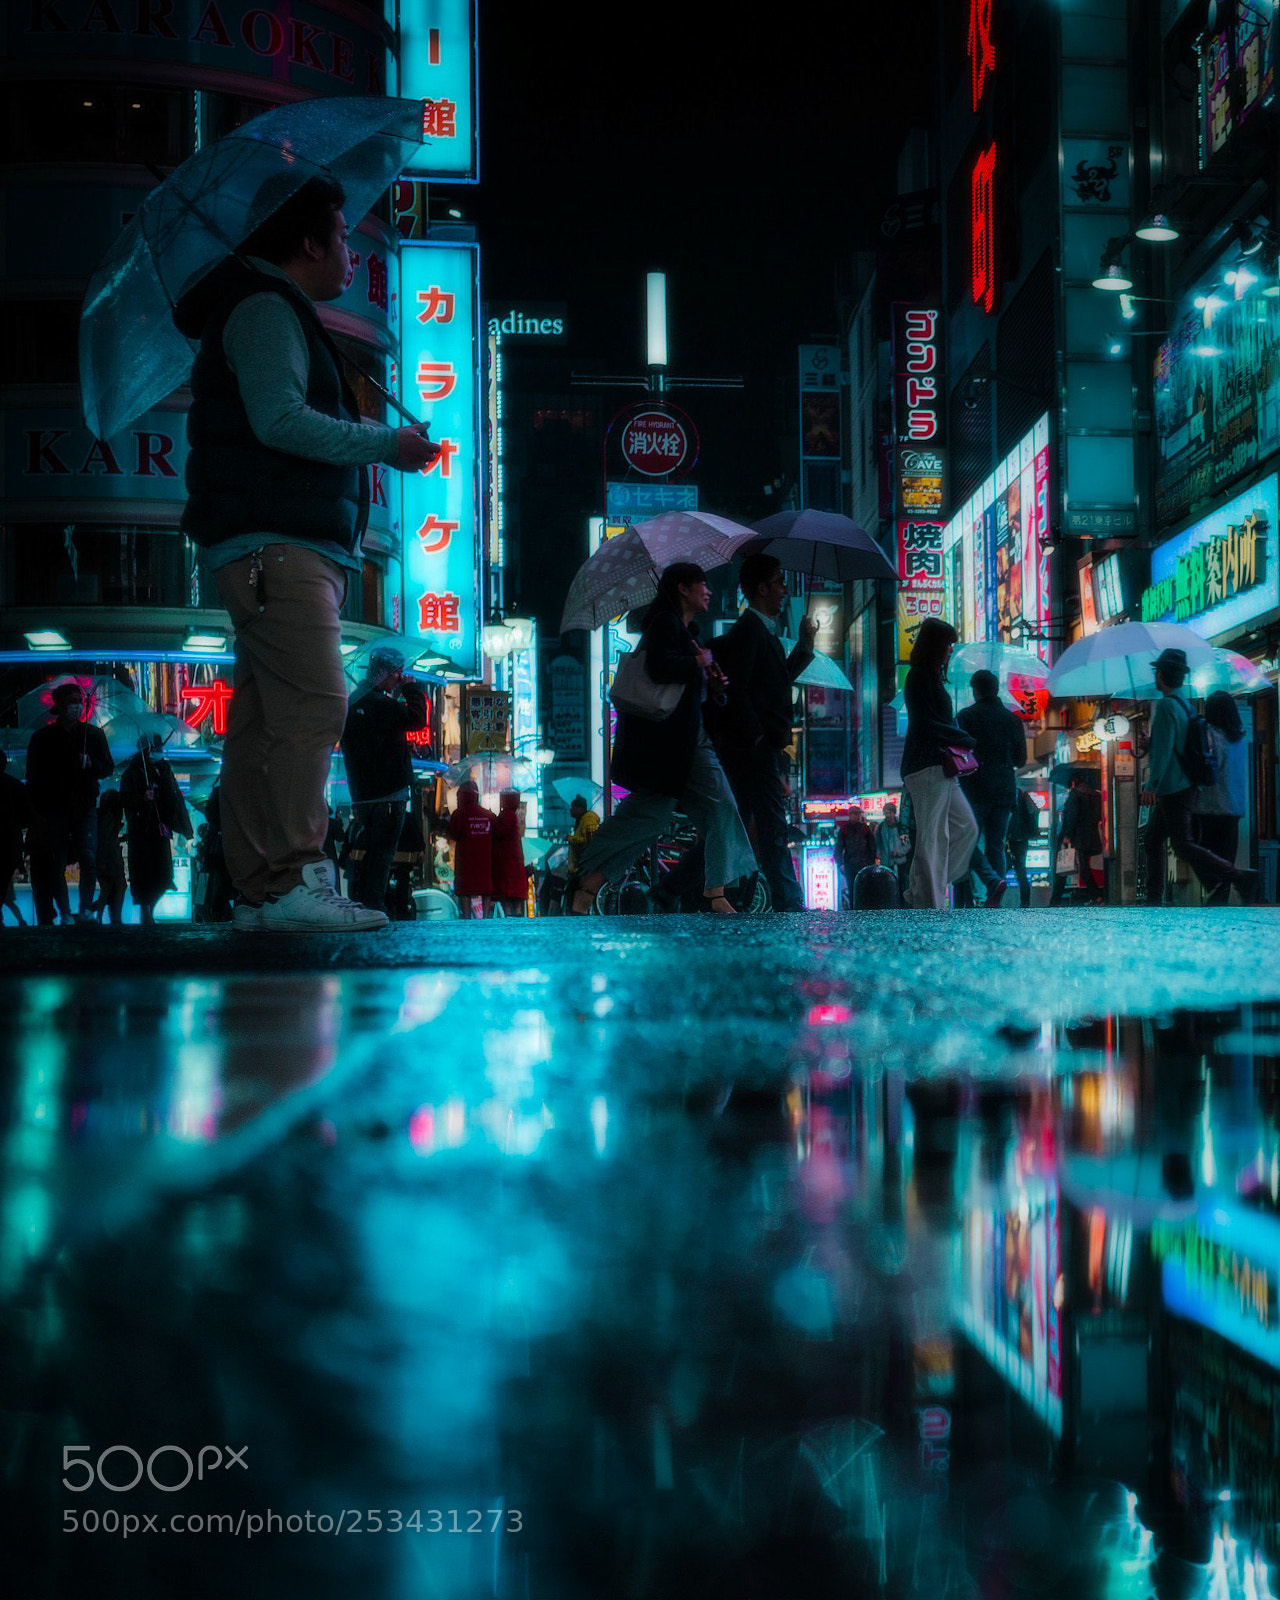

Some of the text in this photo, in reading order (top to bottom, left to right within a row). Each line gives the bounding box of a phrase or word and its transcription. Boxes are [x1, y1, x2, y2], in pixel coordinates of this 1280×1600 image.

[26, 0, 356, 84] KARAOKE
[629, 431, 681, 457] 消火栓
[634, 420, 676, 430] FIRE HYDRANT
[416, 285, 461, 633] カラオケ館
[633, 488, 698, 508] セキネ
[903, 523, 944, 578] 焼肉
[906, 596, 942, 615] 300
[181, 679, 234, 735] オ
